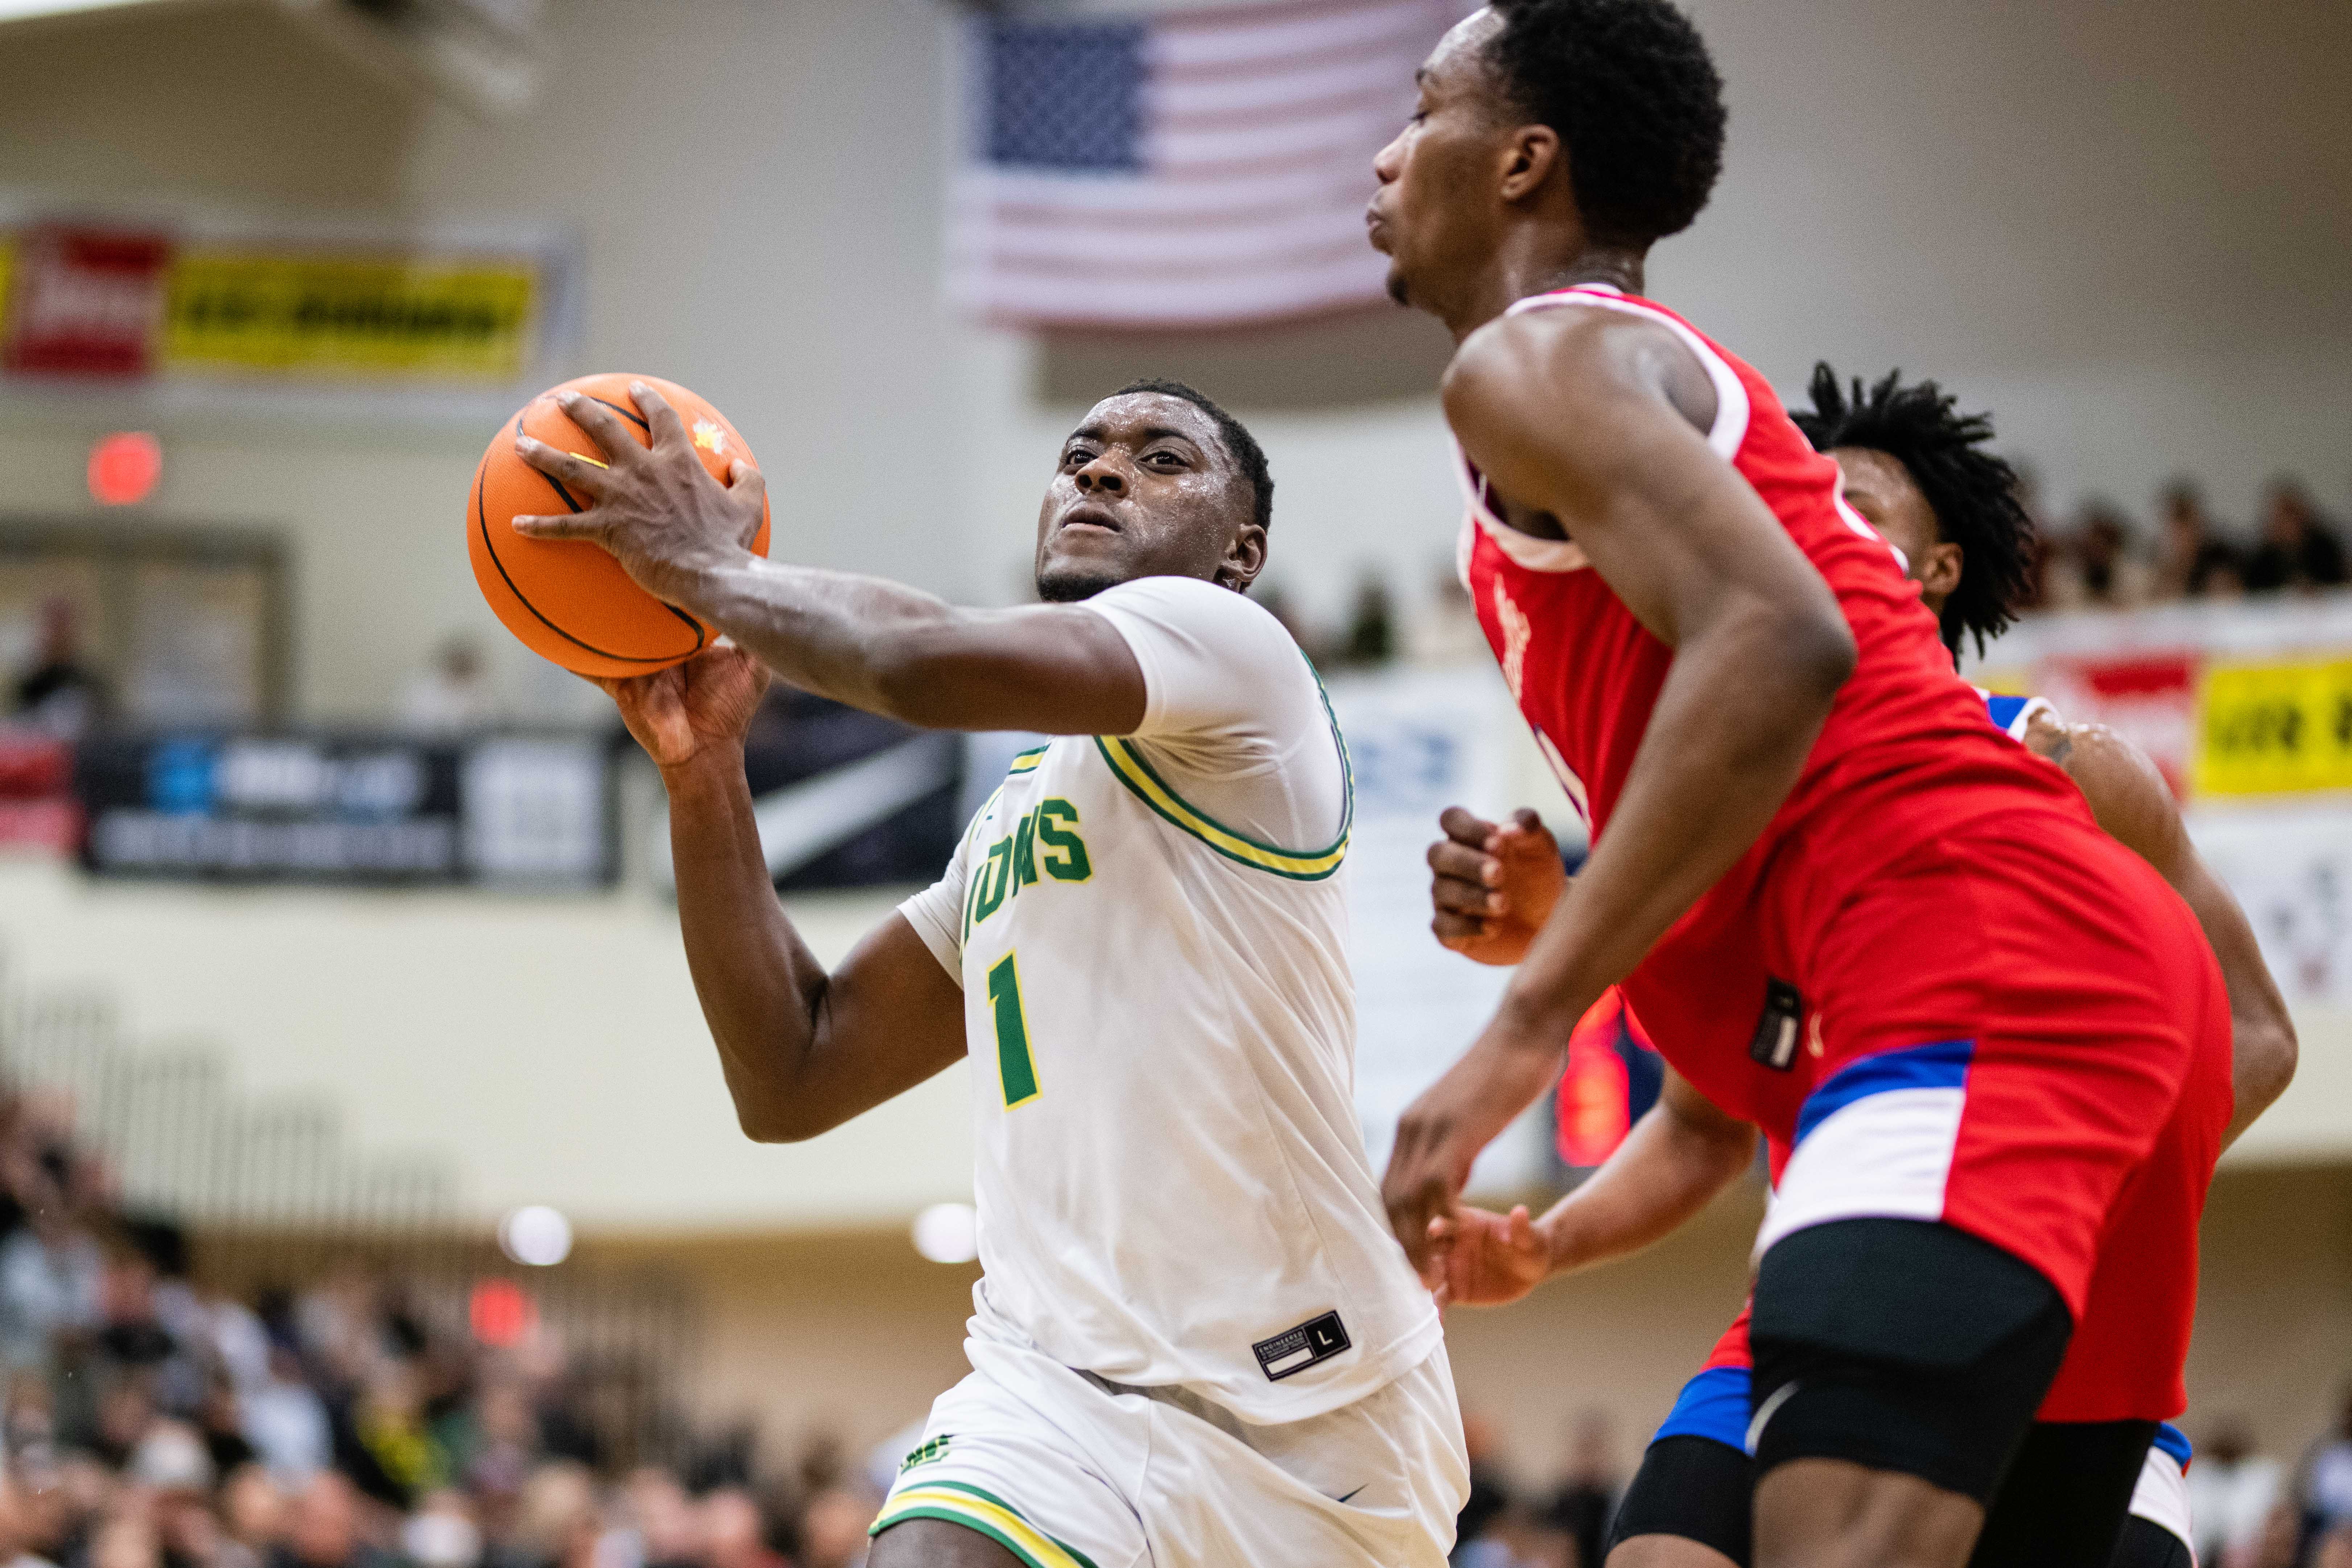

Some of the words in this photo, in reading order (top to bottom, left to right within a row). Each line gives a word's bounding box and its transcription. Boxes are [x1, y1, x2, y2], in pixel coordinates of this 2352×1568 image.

[960, 796, 1093, 952] IONS
[986, 946, 1043, 1113] 1
[1317, 1330, 1334, 1346] L
